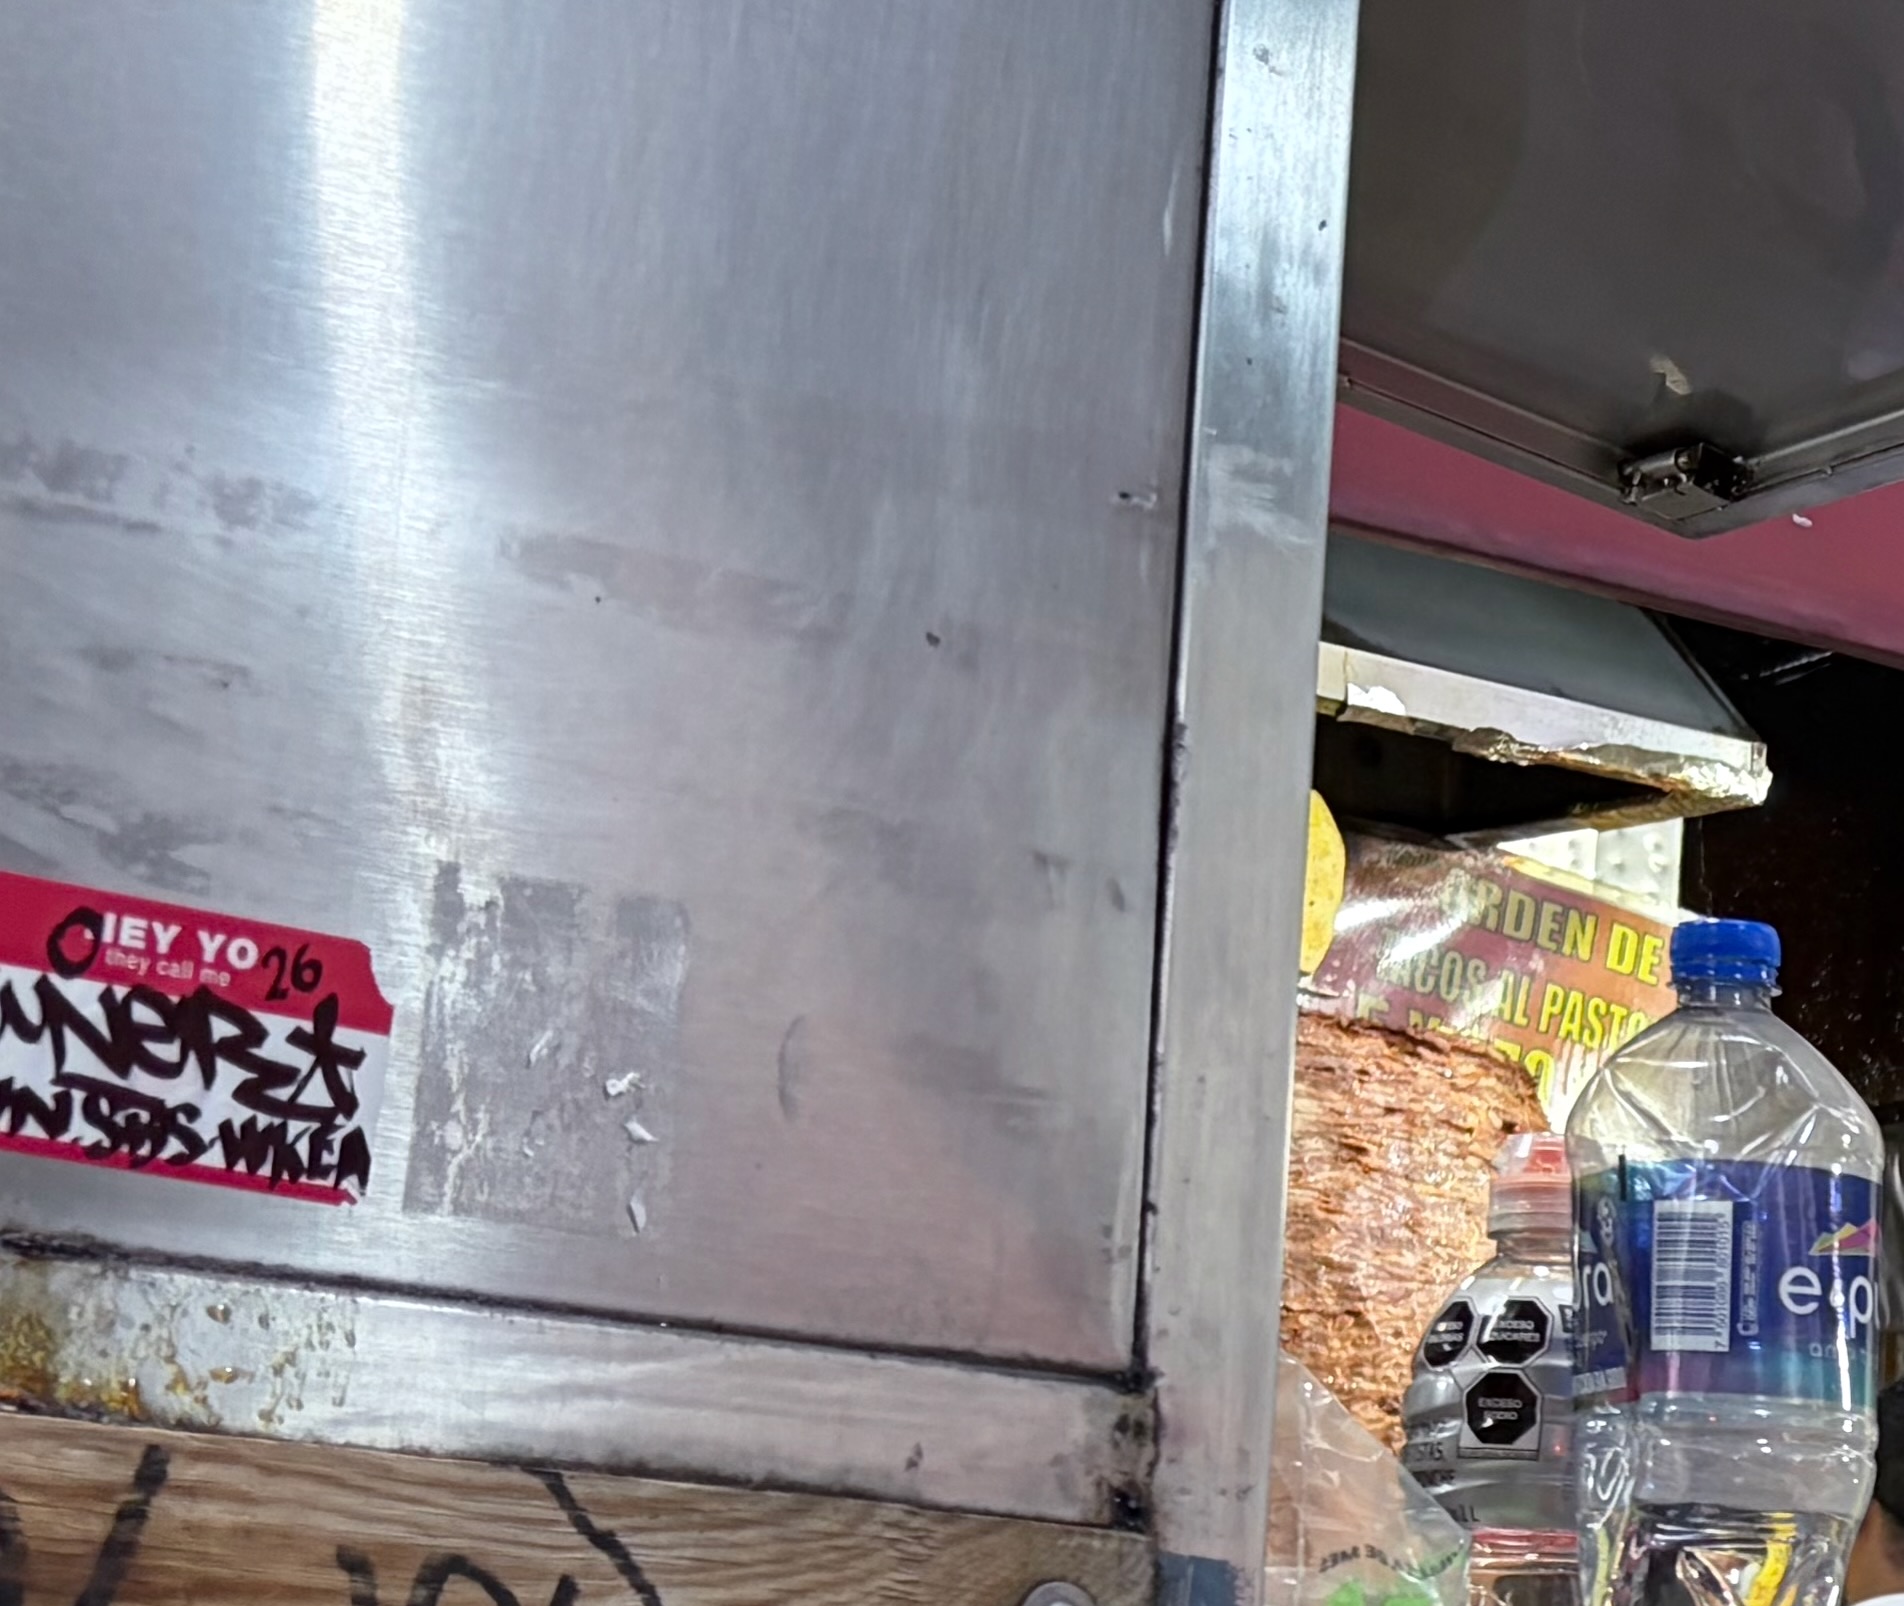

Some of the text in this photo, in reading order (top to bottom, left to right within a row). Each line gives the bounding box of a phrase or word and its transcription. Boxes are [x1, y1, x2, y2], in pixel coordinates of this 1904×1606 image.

[103, 948, 232, 987] they call me
[196, 929, 260, 970] YO
[1605, 921, 1665, 987] DE
[1494, 968, 1532, 1028] AL
[1538, 982, 1653, 1053] PASTO
